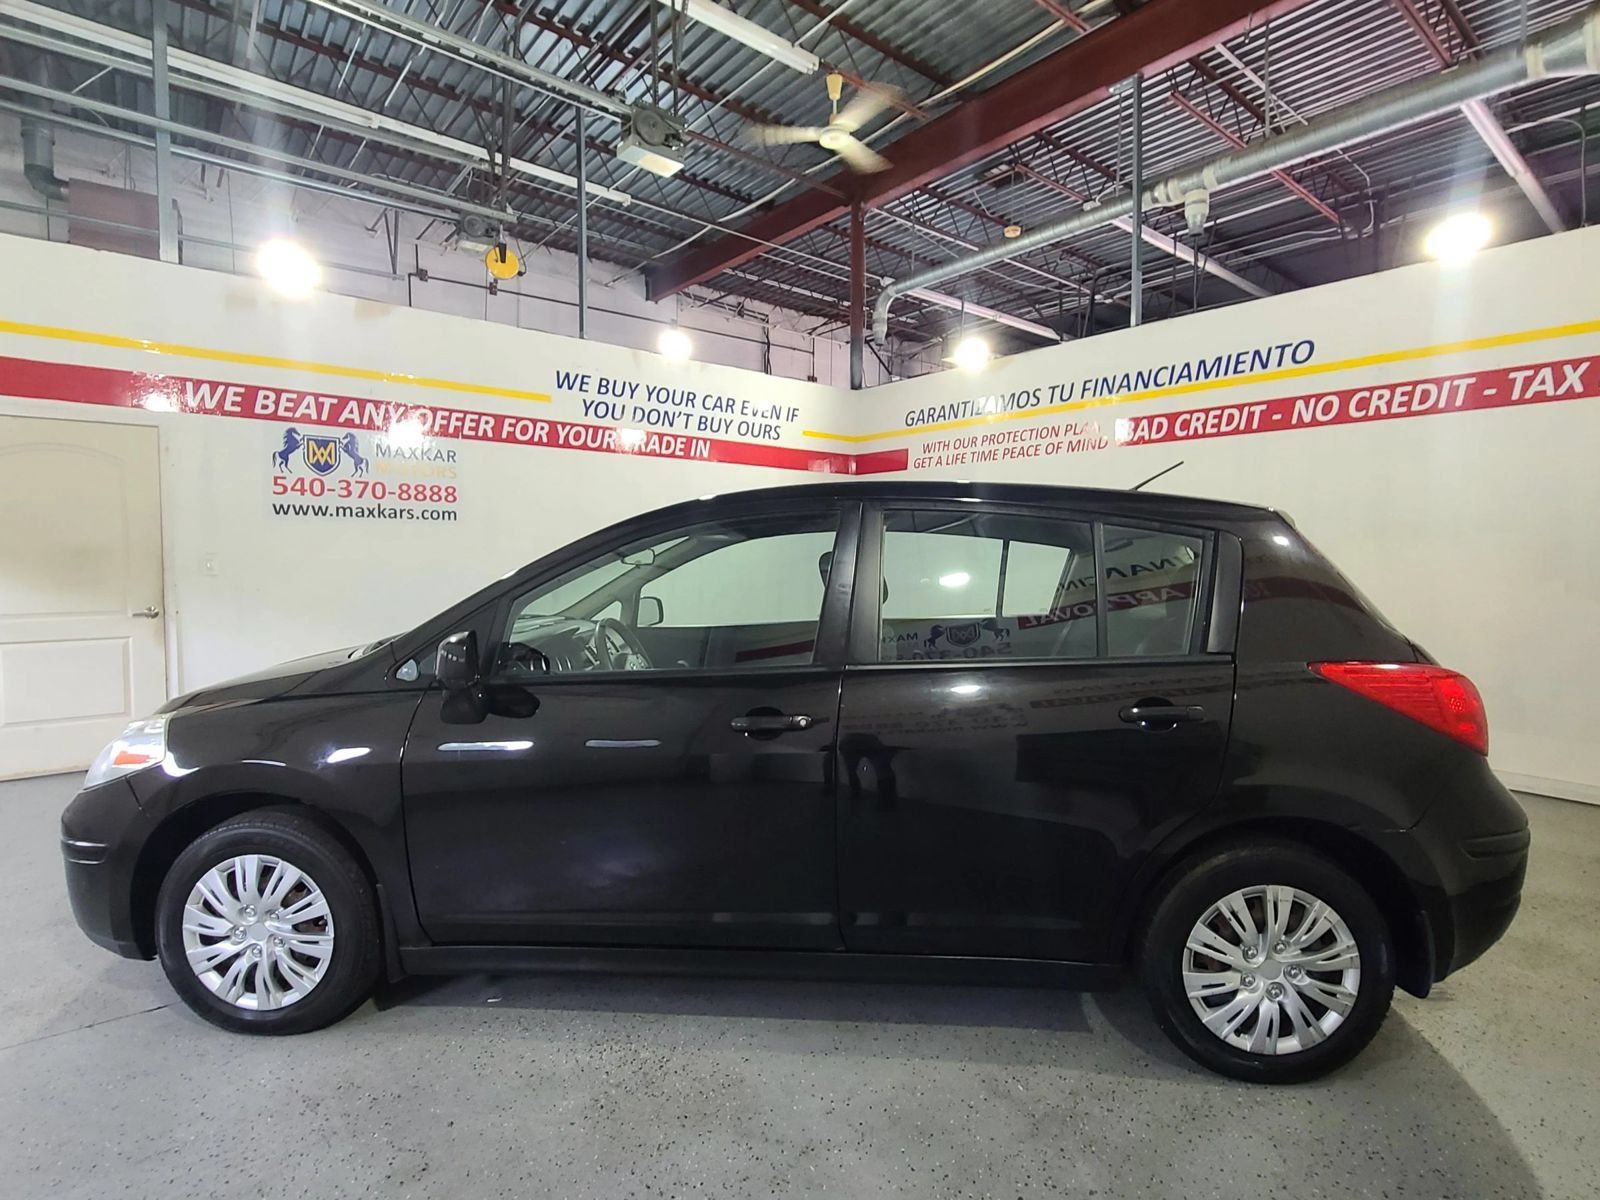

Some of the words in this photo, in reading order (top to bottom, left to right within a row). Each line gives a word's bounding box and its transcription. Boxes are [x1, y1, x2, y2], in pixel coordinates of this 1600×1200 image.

[1048, 382, 1075, 404] TU
[1080, 340, 1315, 399] FINANCIAMIENTO
[556, 370, 591, 393] WE
[597, 377, 640, 399] BUY
[646, 384, 697, 408] YOUR
[702, 394, 736, 414] CAR
[740, 400, 782, 420] EVEN
[786, 406, 799, 422] IF
[1174, 404, 1267, 436] CREDIT
[1290, 395, 1340, 424] NO
[1348, 377, 1477, 418] CREDIT
[1508, 361, 1591, 400] TAX
[185, 381, 245, 412] WE
[254, 389, 338, 421] BEAT
[338, 399, 405, 430] ANY
[415, 408, 496, 437] OFFER
[501, 417, 549, 443] FOR
[556, 424, 617, 450] YOUR
[622, 429, 685, 457] RADE
[690, 439, 711, 458] IN
[582, 398, 626, 421] YOU
[631, 405, 694, 430] DON'T
[697, 415, 734, 435] BUY
[737, 420, 781, 440] OURS
[375, 443, 457, 463] MAXKAR
[913, 456, 934, 469] GET
[935, 455, 943, 467] A
[945, 452, 967, 465] LIFE
[970, 448, 999, 463] TIME
[1002, 444, 1041, 460] PEACE
[1045, 441, 1063, 455] OF
[1066, 437, 1109, 454] MIND
[922, 440, 950, 454] WITH
[953, 436, 978, 449] OUR
[981, 424, 1061, 447] PROTECTION
[272, 475, 458, 503] 540-370-8888
[272, 503, 458, 521] www.maxkars.com
